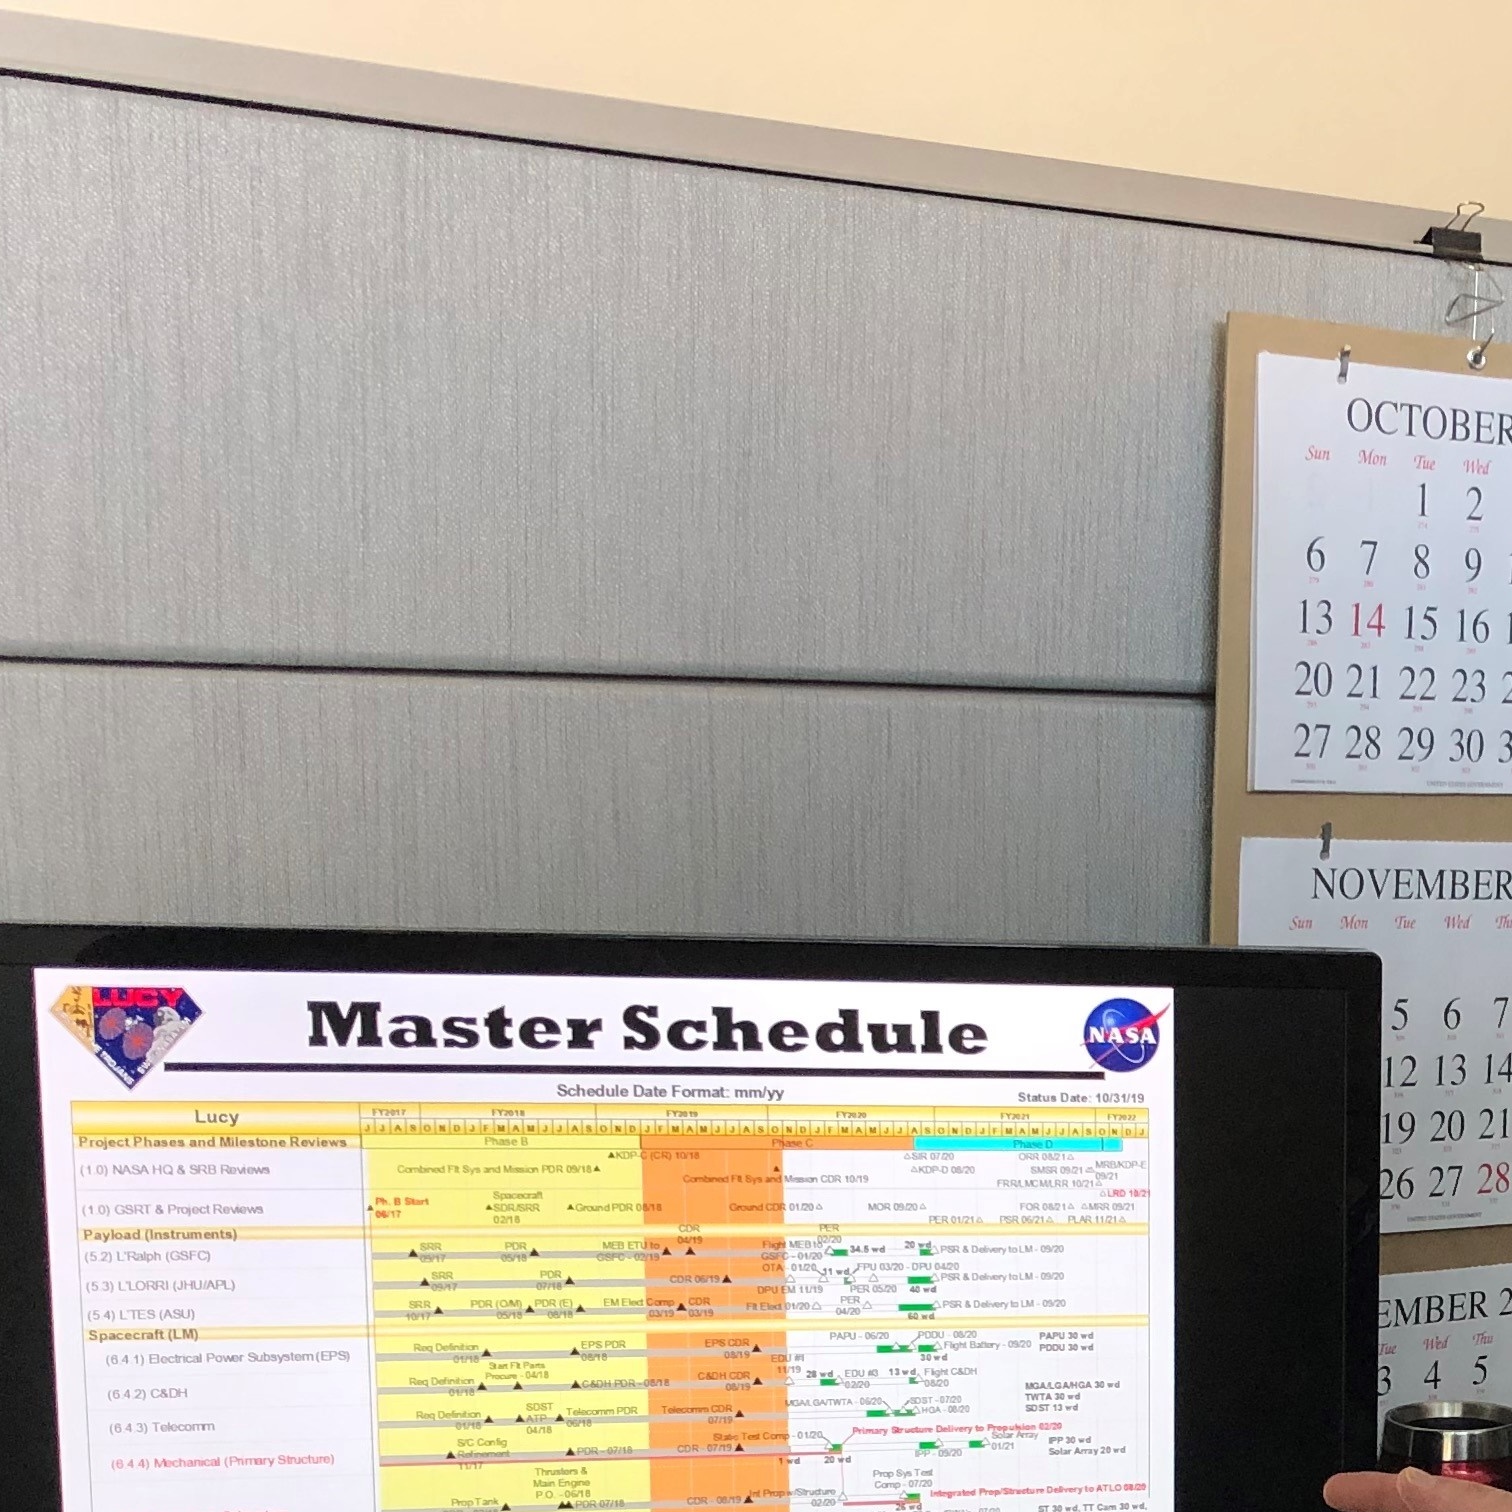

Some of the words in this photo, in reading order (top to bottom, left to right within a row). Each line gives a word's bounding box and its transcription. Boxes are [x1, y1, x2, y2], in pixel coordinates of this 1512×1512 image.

[1304, 445, 1330, 461] Sun
[1357, 449, 1387, 466] Mon
[1413, 455, 1436, 470] Tue
[1462, 459, 1493, 475] Wed
[1415, 482, 1430, 518] 1
[1466, 487, 1483, 521] 2
[1306, 537, 1326, 572] 6
[1360, 540, 1378, 575] 7
[1413, 544, 1430, 579] 8
[1464, 548, 1482, 582] 9
[1301, 599, 1333, 634] 13
[1351, 603, 1386, 637] 14
[1406, 606, 1438, 640] 15
[1458, 609, 1490, 643] 16
[1294, 661, 1333, 697] 20
[1346, 664, 1379, 698] 21
[1398, 666, 1437, 700] 22
[1451, 669, 1486, 702] 23
[1294, 723, 1331, 758] 27
[1344, 725, 1381, 759] 28
[1397, 727, 1435, 761] 29
[1449, 729, 1485, 762] 30
[1288, 916, 1313, 930] Sun
[1339, 914, 1369, 929] Mon
[1394, 916, 1417, 929] Tue
[1443, 914, 1473, 929] Wed
[93, 986, 182, 1007] LUCY
[1390, 999, 1409, 1030] 5
[1443, 998, 1461, 1030] 6
[1493, 997, 1509, 1028] 7
[307, 1001, 602, 1049] Master
[623, 1005, 987, 1054] Schedule
[1089, 1026, 1157, 1045] NASA
[1384, 1055, 1418, 1087] 12
[1436, 1054, 1467, 1086] 13
[556, 1083, 630, 1101] Schedule
[633, 1084, 668, 1101] Date
[672, 1085, 729, 1098] Format:
[735, 1086, 784, 1101] mm/yy
[1018, 1092, 1056, 1102] Status
[1060, 1092, 1092, 1104] Date:
[1096, 1093, 1144, 1103] 10/31/19
[195, 1109, 240, 1127] Lucy
[1382, 1112, 1416, 1144] 19
[1429, 1110, 1465, 1142] 20
[1478, 1108, 1509, 1139] 21
[78, 1136, 131, 1150] Project
[133, 1136, 185, 1148] Phases
[189, 1136, 215, 1148] and
[219, 1136, 286, 1148] Milestone
[290, 1136, 348, 1148] Reviews
[113, 1165, 149, 1175] NASA
[152, 1164, 173, 1175] HQ
[190, 1164, 216, 1175] SRB
[221, 1165, 270, 1174] Reviews
[1378, 1166, 1415, 1201] 26
[1428, 1166, 1463, 1197] 27
[1476, 1162, 1510, 1194] 28
[115, 1204, 151, 1215] GSRT
[168, 1204, 210, 1216] Project
[213, 1204, 263, 1214] Reviews
[83, 1228, 142, 1243] Payload
[145, 1227, 238, 1241] (Instruments)
[117, 1251, 161, 1263] L'Ralph
[166, 1250, 210, 1263] (GSFC)
[1378, 1291, 1489, 1329] EMBER
[89, 1329, 165, 1343] Spacecraft
[168, 1328, 199, 1342] (LM)
[1422, 1335, 1451, 1351] Wed
[1471, 1330, 1495, 1346] Thu
[149, 1353, 202, 1364] Electrical
[206, 1353, 244, 1362] Power
[248, 1352, 314, 1364] Subsystem
[316, 1351, 350, 1363] (EPS)
[1377, 1366, 1393, 1396] 3
[1423, 1361, 1442, 1389] 4
[1471, 1356, 1489, 1386] 5
[152, 1422, 215, 1432] Telecomm
[154, 1457, 220, 1468] Mechanical
[224, 1456, 275, 1468] (Primary
[278, 1454, 334, 1464] Structure)
